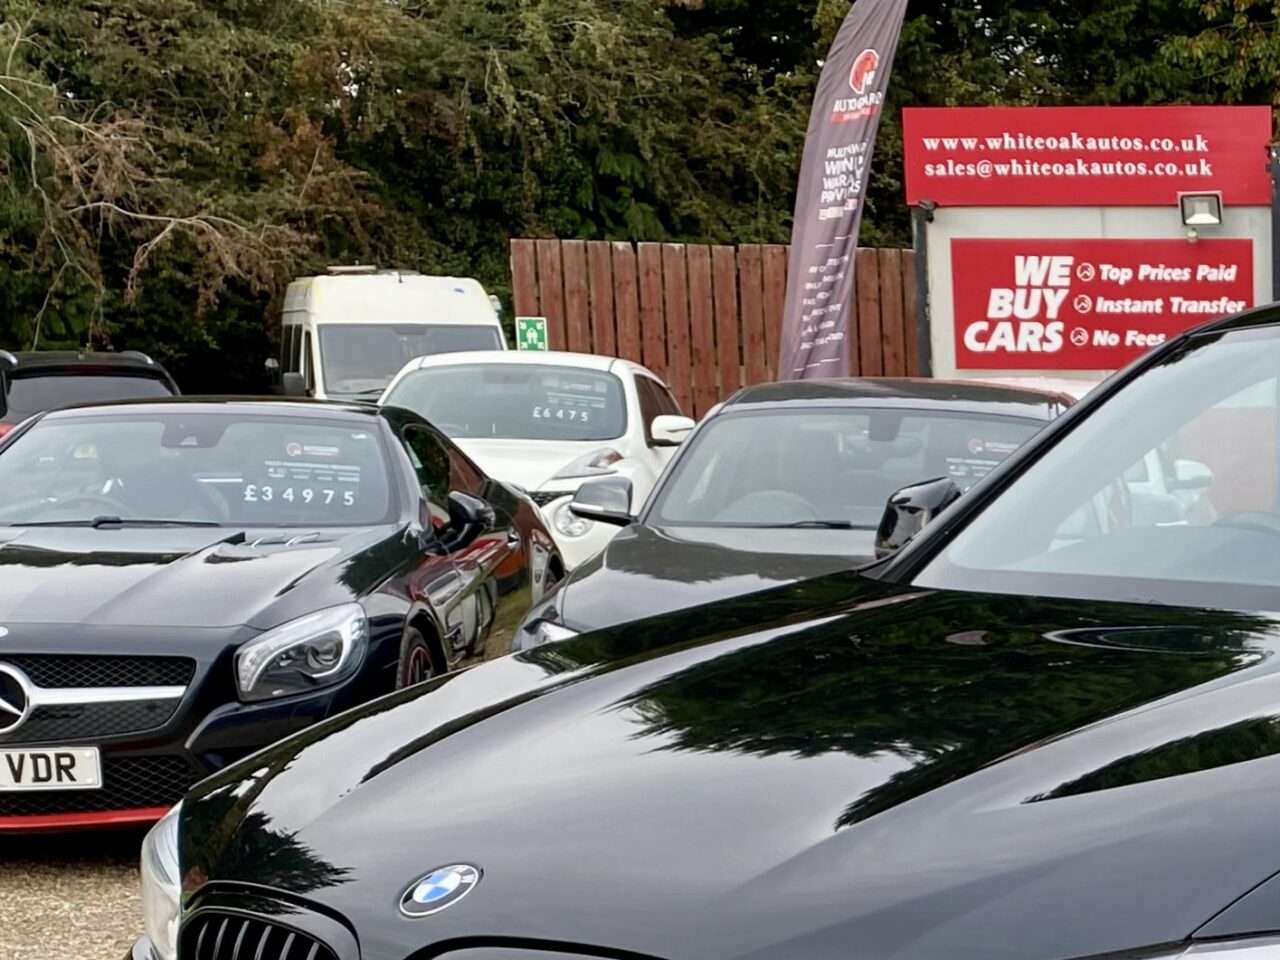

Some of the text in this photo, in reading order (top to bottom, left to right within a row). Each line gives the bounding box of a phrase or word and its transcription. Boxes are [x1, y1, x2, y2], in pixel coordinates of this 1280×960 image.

[923, 133, 1208, 151] www.whiteoakautos.co.uk
[925, 159, 1212, 177] sales@whiteoakautos.co.uk
[1014, 256, 1074, 286] WE
[1100, 264, 1237, 285] Top Prices Paid
[987, 288, 1069, 319] BUY
[1096, 297, 1245, 314] Instant Transfer
[964, 321, 1064, 352] CARS
[1093, 330, 1166, 348] No Fees
[532, 406, 588, 421] £6475
[244, 484, 354, 505] £34975
[6, 753, 76, 782] VDR
